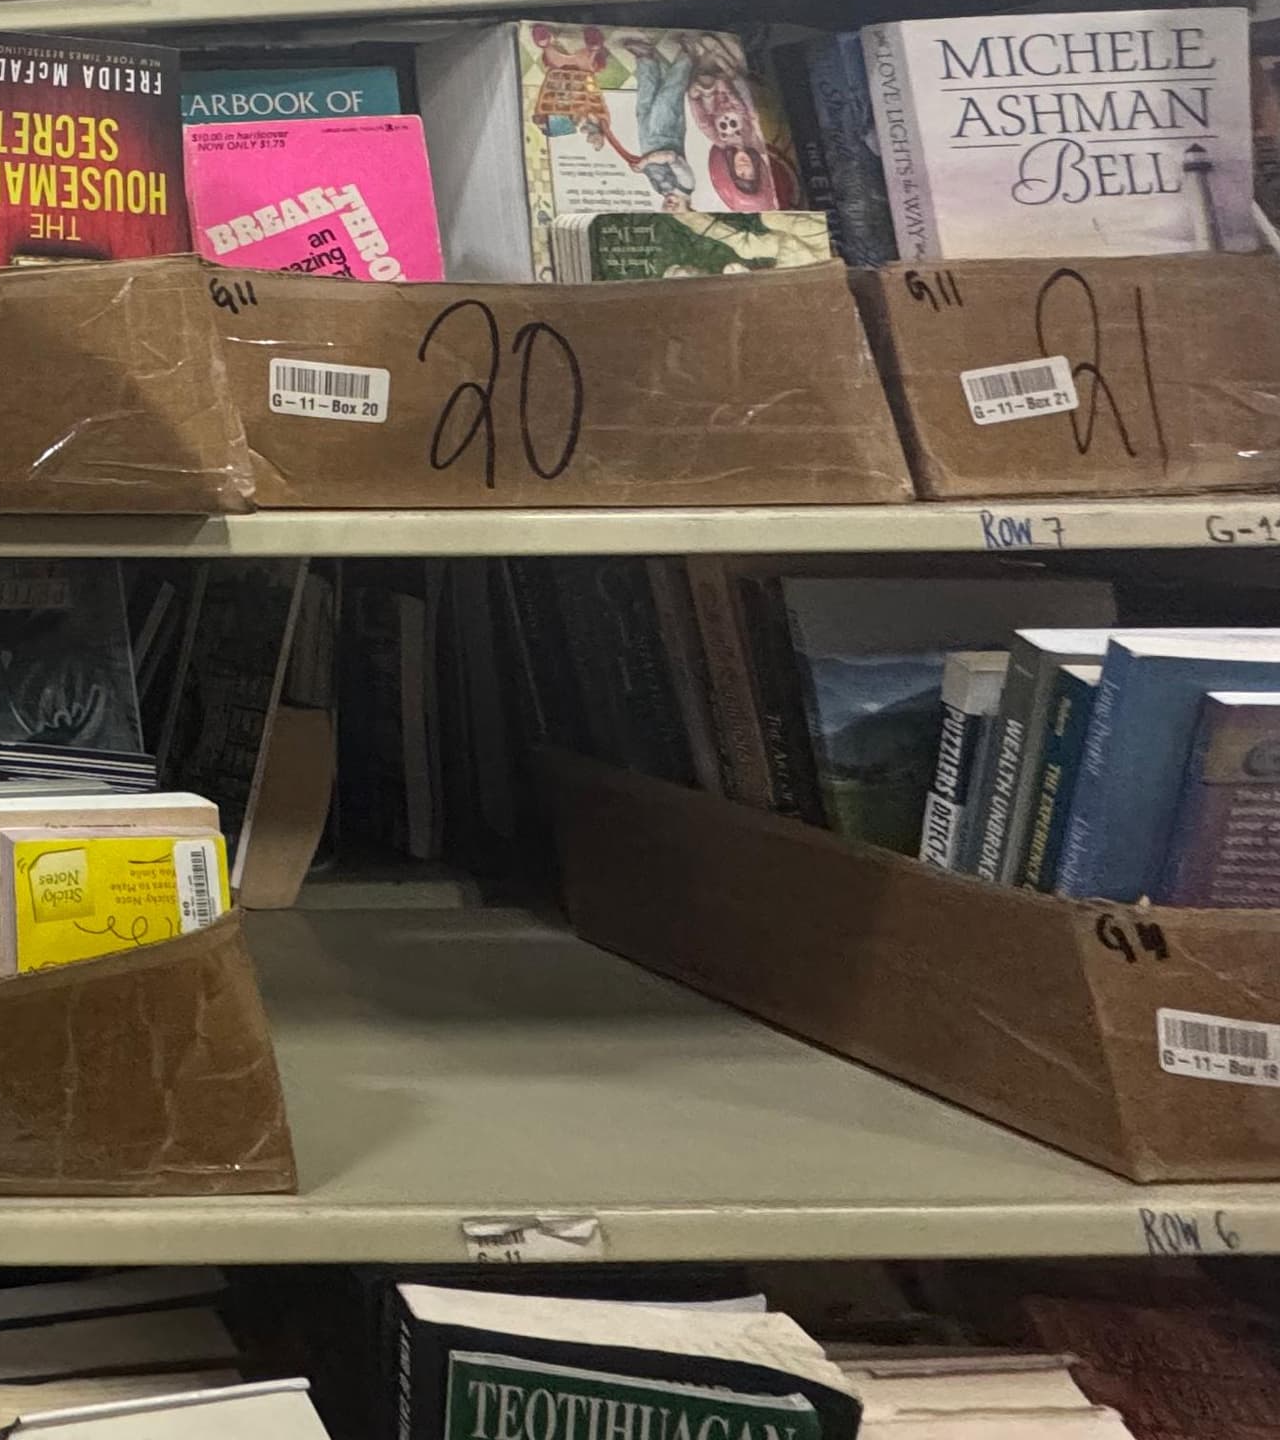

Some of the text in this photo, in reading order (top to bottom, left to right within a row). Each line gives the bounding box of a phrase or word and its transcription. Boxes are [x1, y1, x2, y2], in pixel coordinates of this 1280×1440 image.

[69, 52, 101, 63] TIMES
[105, 55, 135, 65] YORK
[140, 58, 161, 68] NEW
[934, 27, 1217, 81] MICHELE
[83, 65, 162, 95] FREIDA
[326, 90, 364, 113] OF
[950, 87, 1215, 140] ASHMAN
[237, 130, 288, 141] hardcover
[198, 140, 257, 152] NOW ONLY
[30, 213, 81, 241] THE
[307, 228, 336, 249] an
[418, 299, 583, 489] 20
[1054, 391, 1072, 407] 21
[361, 401, 379, 416] 20
[1042, 517, 1066, 548] 7
[39, 869, 79, 887] Notes
[41, 886, 85, 904] Sticky
